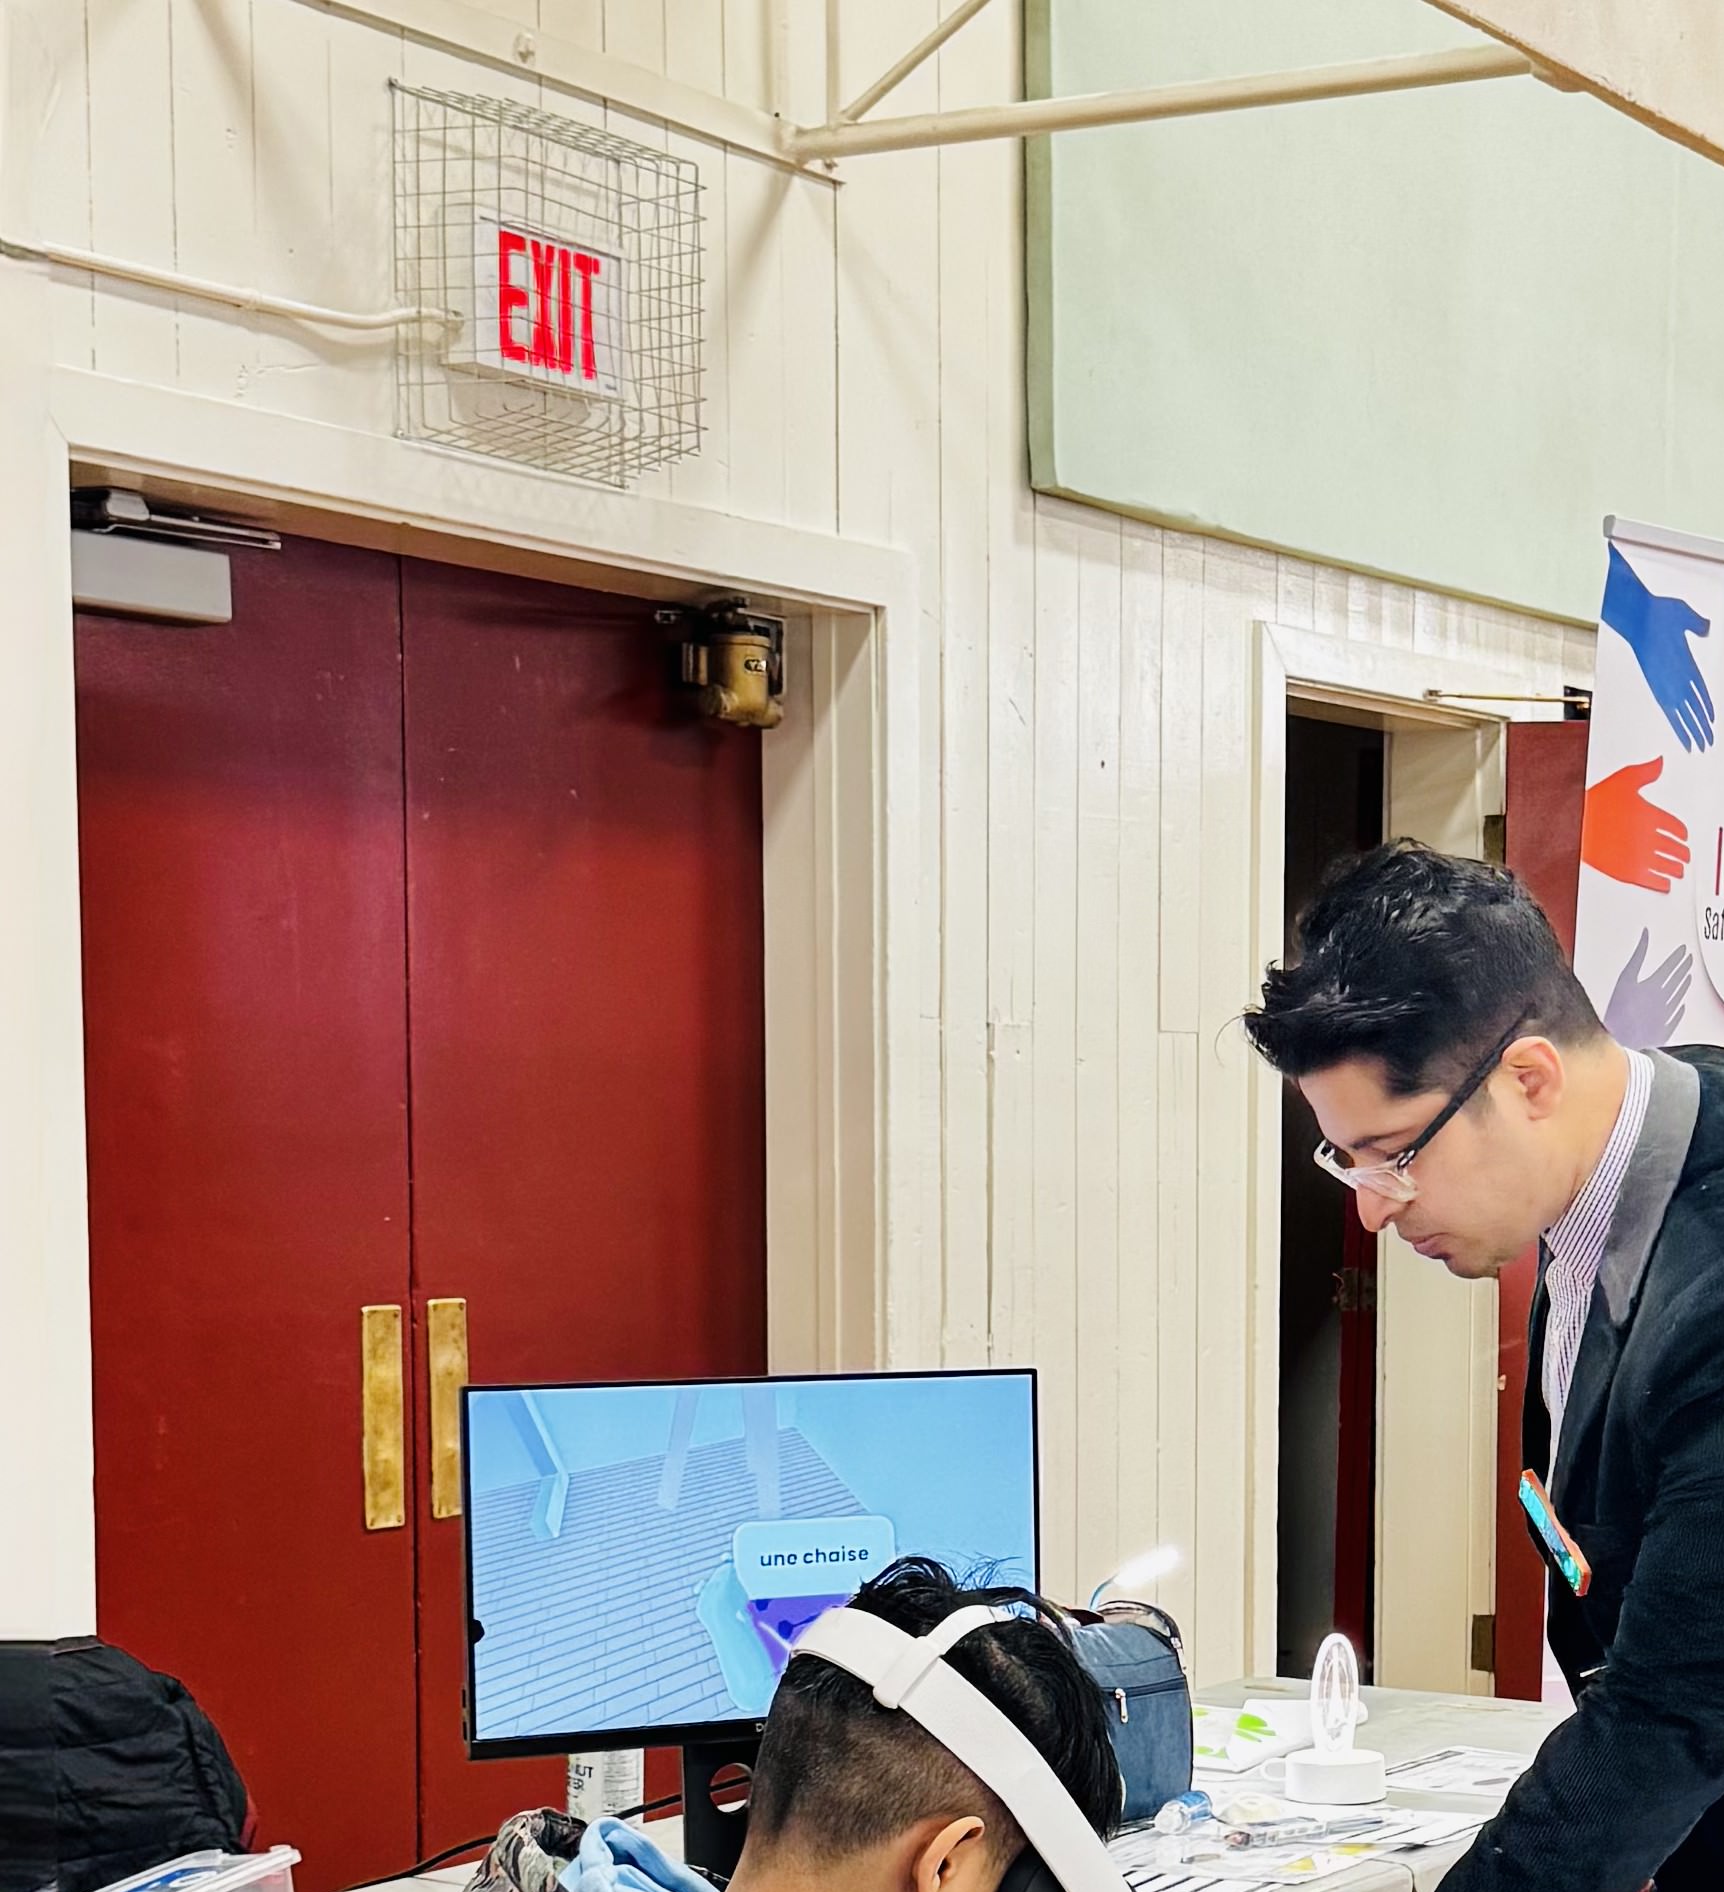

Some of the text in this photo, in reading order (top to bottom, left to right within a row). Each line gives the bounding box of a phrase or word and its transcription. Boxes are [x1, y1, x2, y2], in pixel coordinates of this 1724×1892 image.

[499, 230, 600, 380] EXIT
[760, 1546, 869, 1567] une chaise
